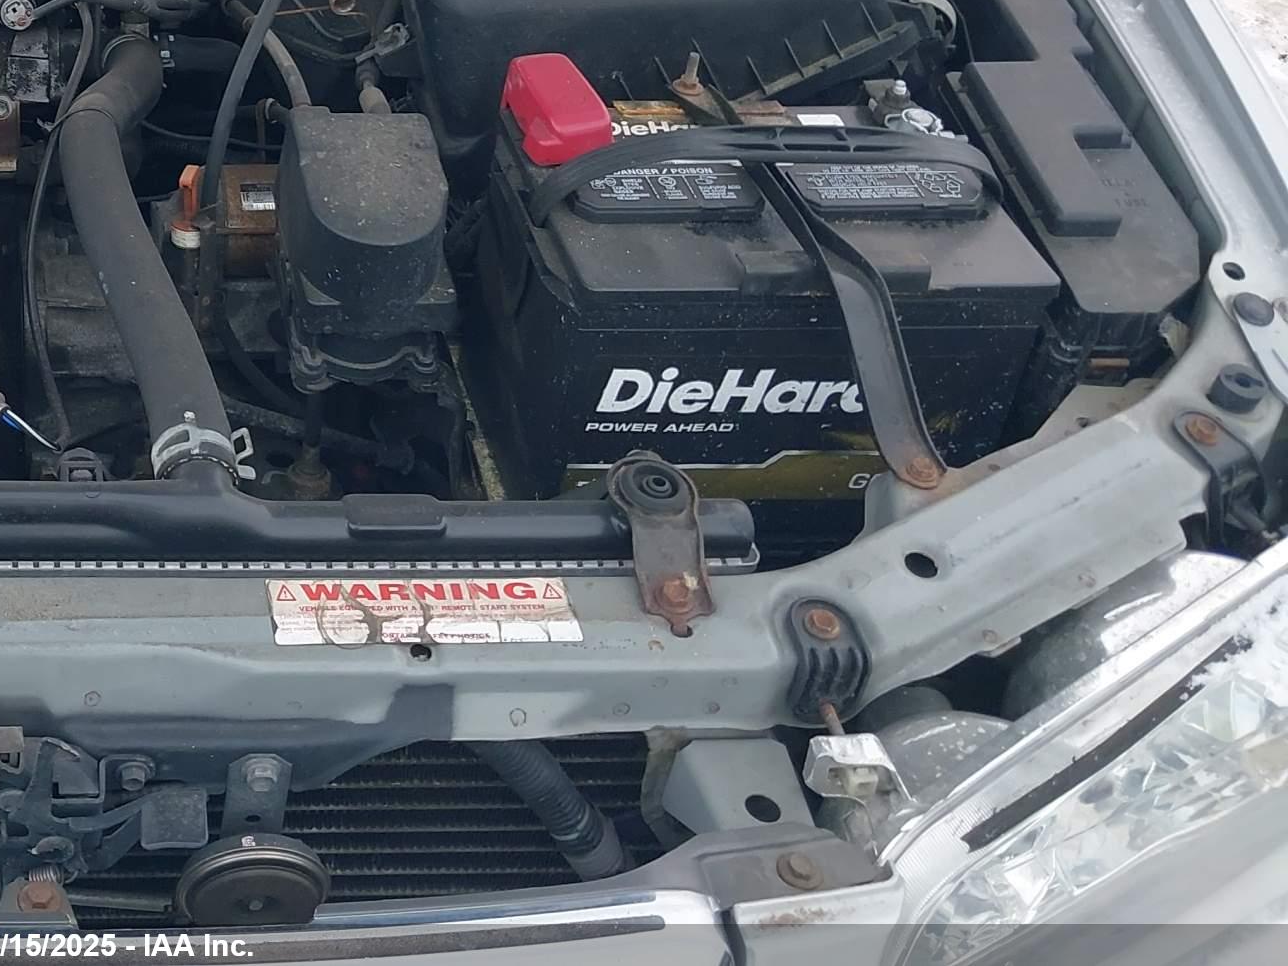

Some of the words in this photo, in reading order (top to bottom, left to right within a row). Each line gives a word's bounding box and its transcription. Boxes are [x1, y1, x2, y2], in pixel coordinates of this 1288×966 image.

[669, 166, 713, 175] POISON
[584, 422, 658, 433] POWER
[662, 422, 735, 433] AHEAD
[300, 581, 538, 601] WARNING
